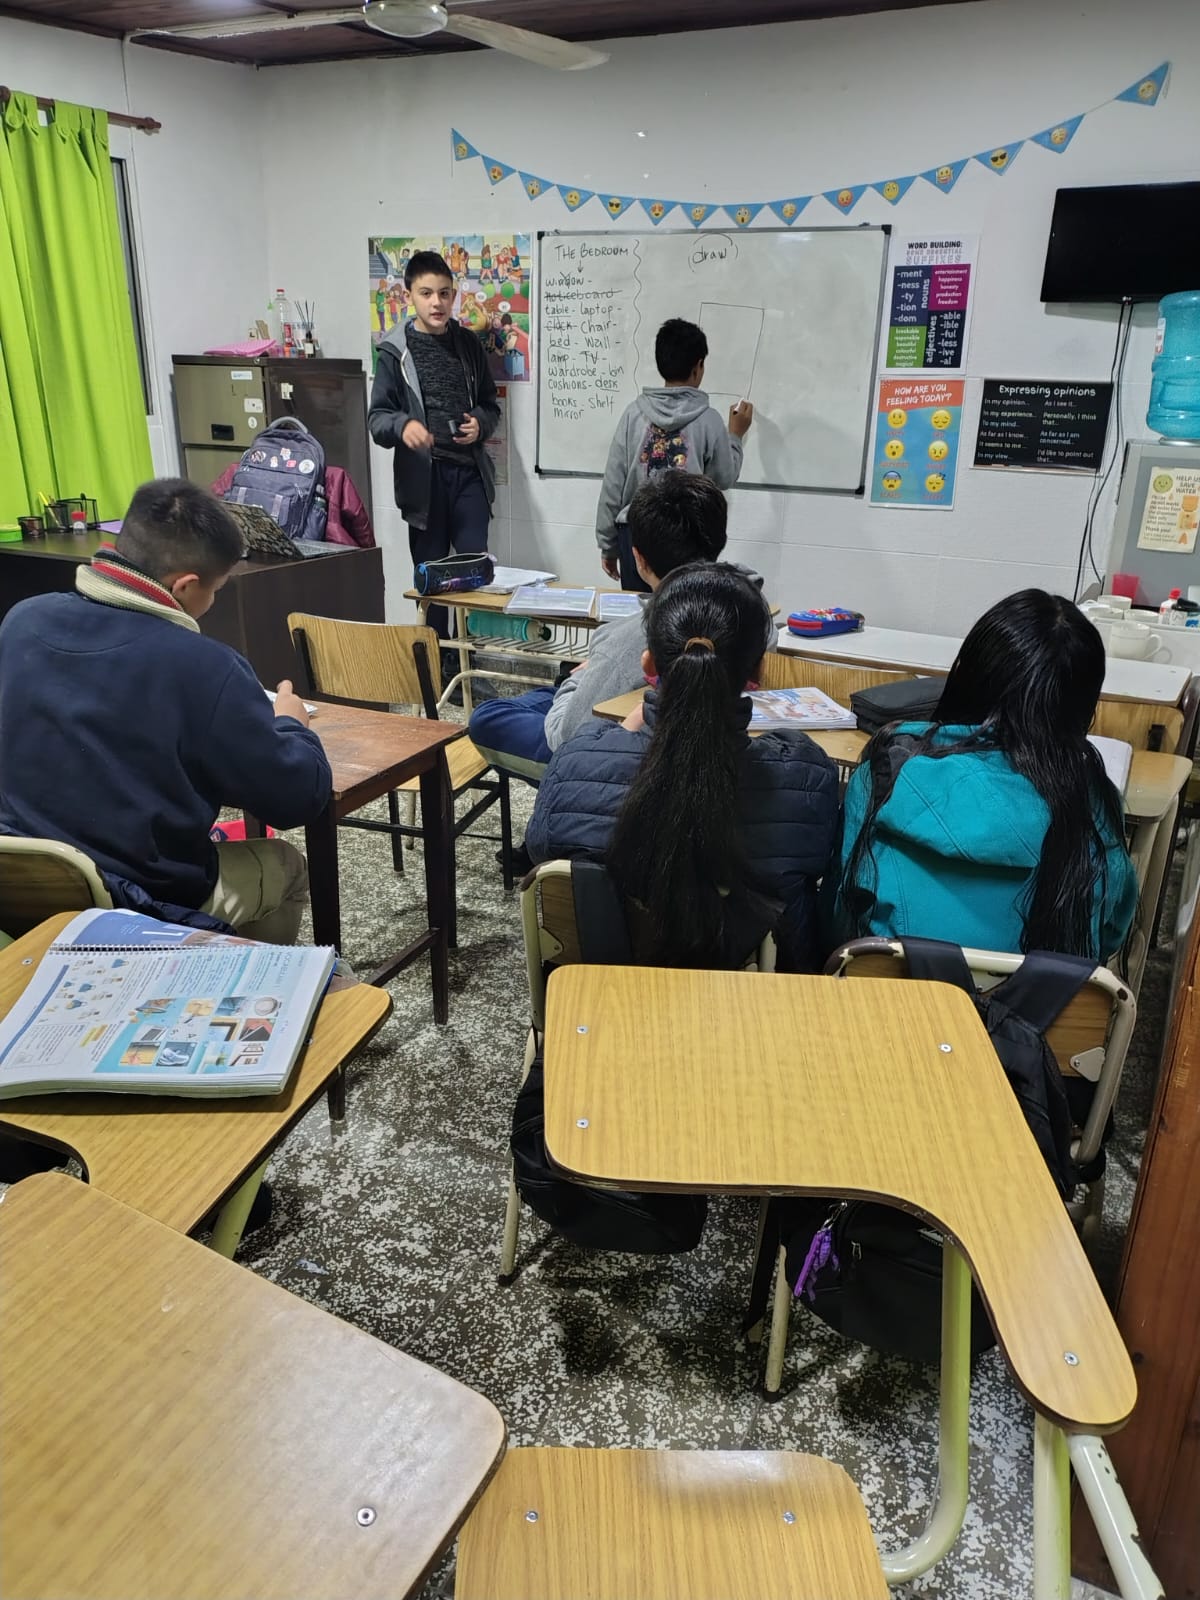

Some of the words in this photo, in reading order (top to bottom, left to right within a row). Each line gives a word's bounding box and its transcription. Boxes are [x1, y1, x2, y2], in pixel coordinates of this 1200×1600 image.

[555, 244, 575, 261] THE
[580, 242, 628, 257] BEDROOM
[901, 292, 914, 302] -ty
[921, 279, 930, 308] nouns
[926, 315, 937, 363] adjectives
[938, 339, 957, 347] -less
[895, 386, 912, 395] HOW
[914, 385, 929, 394] ARE
[930, 383, 947, 392] YOU
[1000, 385, 1051, 398] Expressing
[1054, 386, 1096, 397] opinions
[886, 397, 919, 406] FEELING
[920, 393, 952, 402] TODAY?
